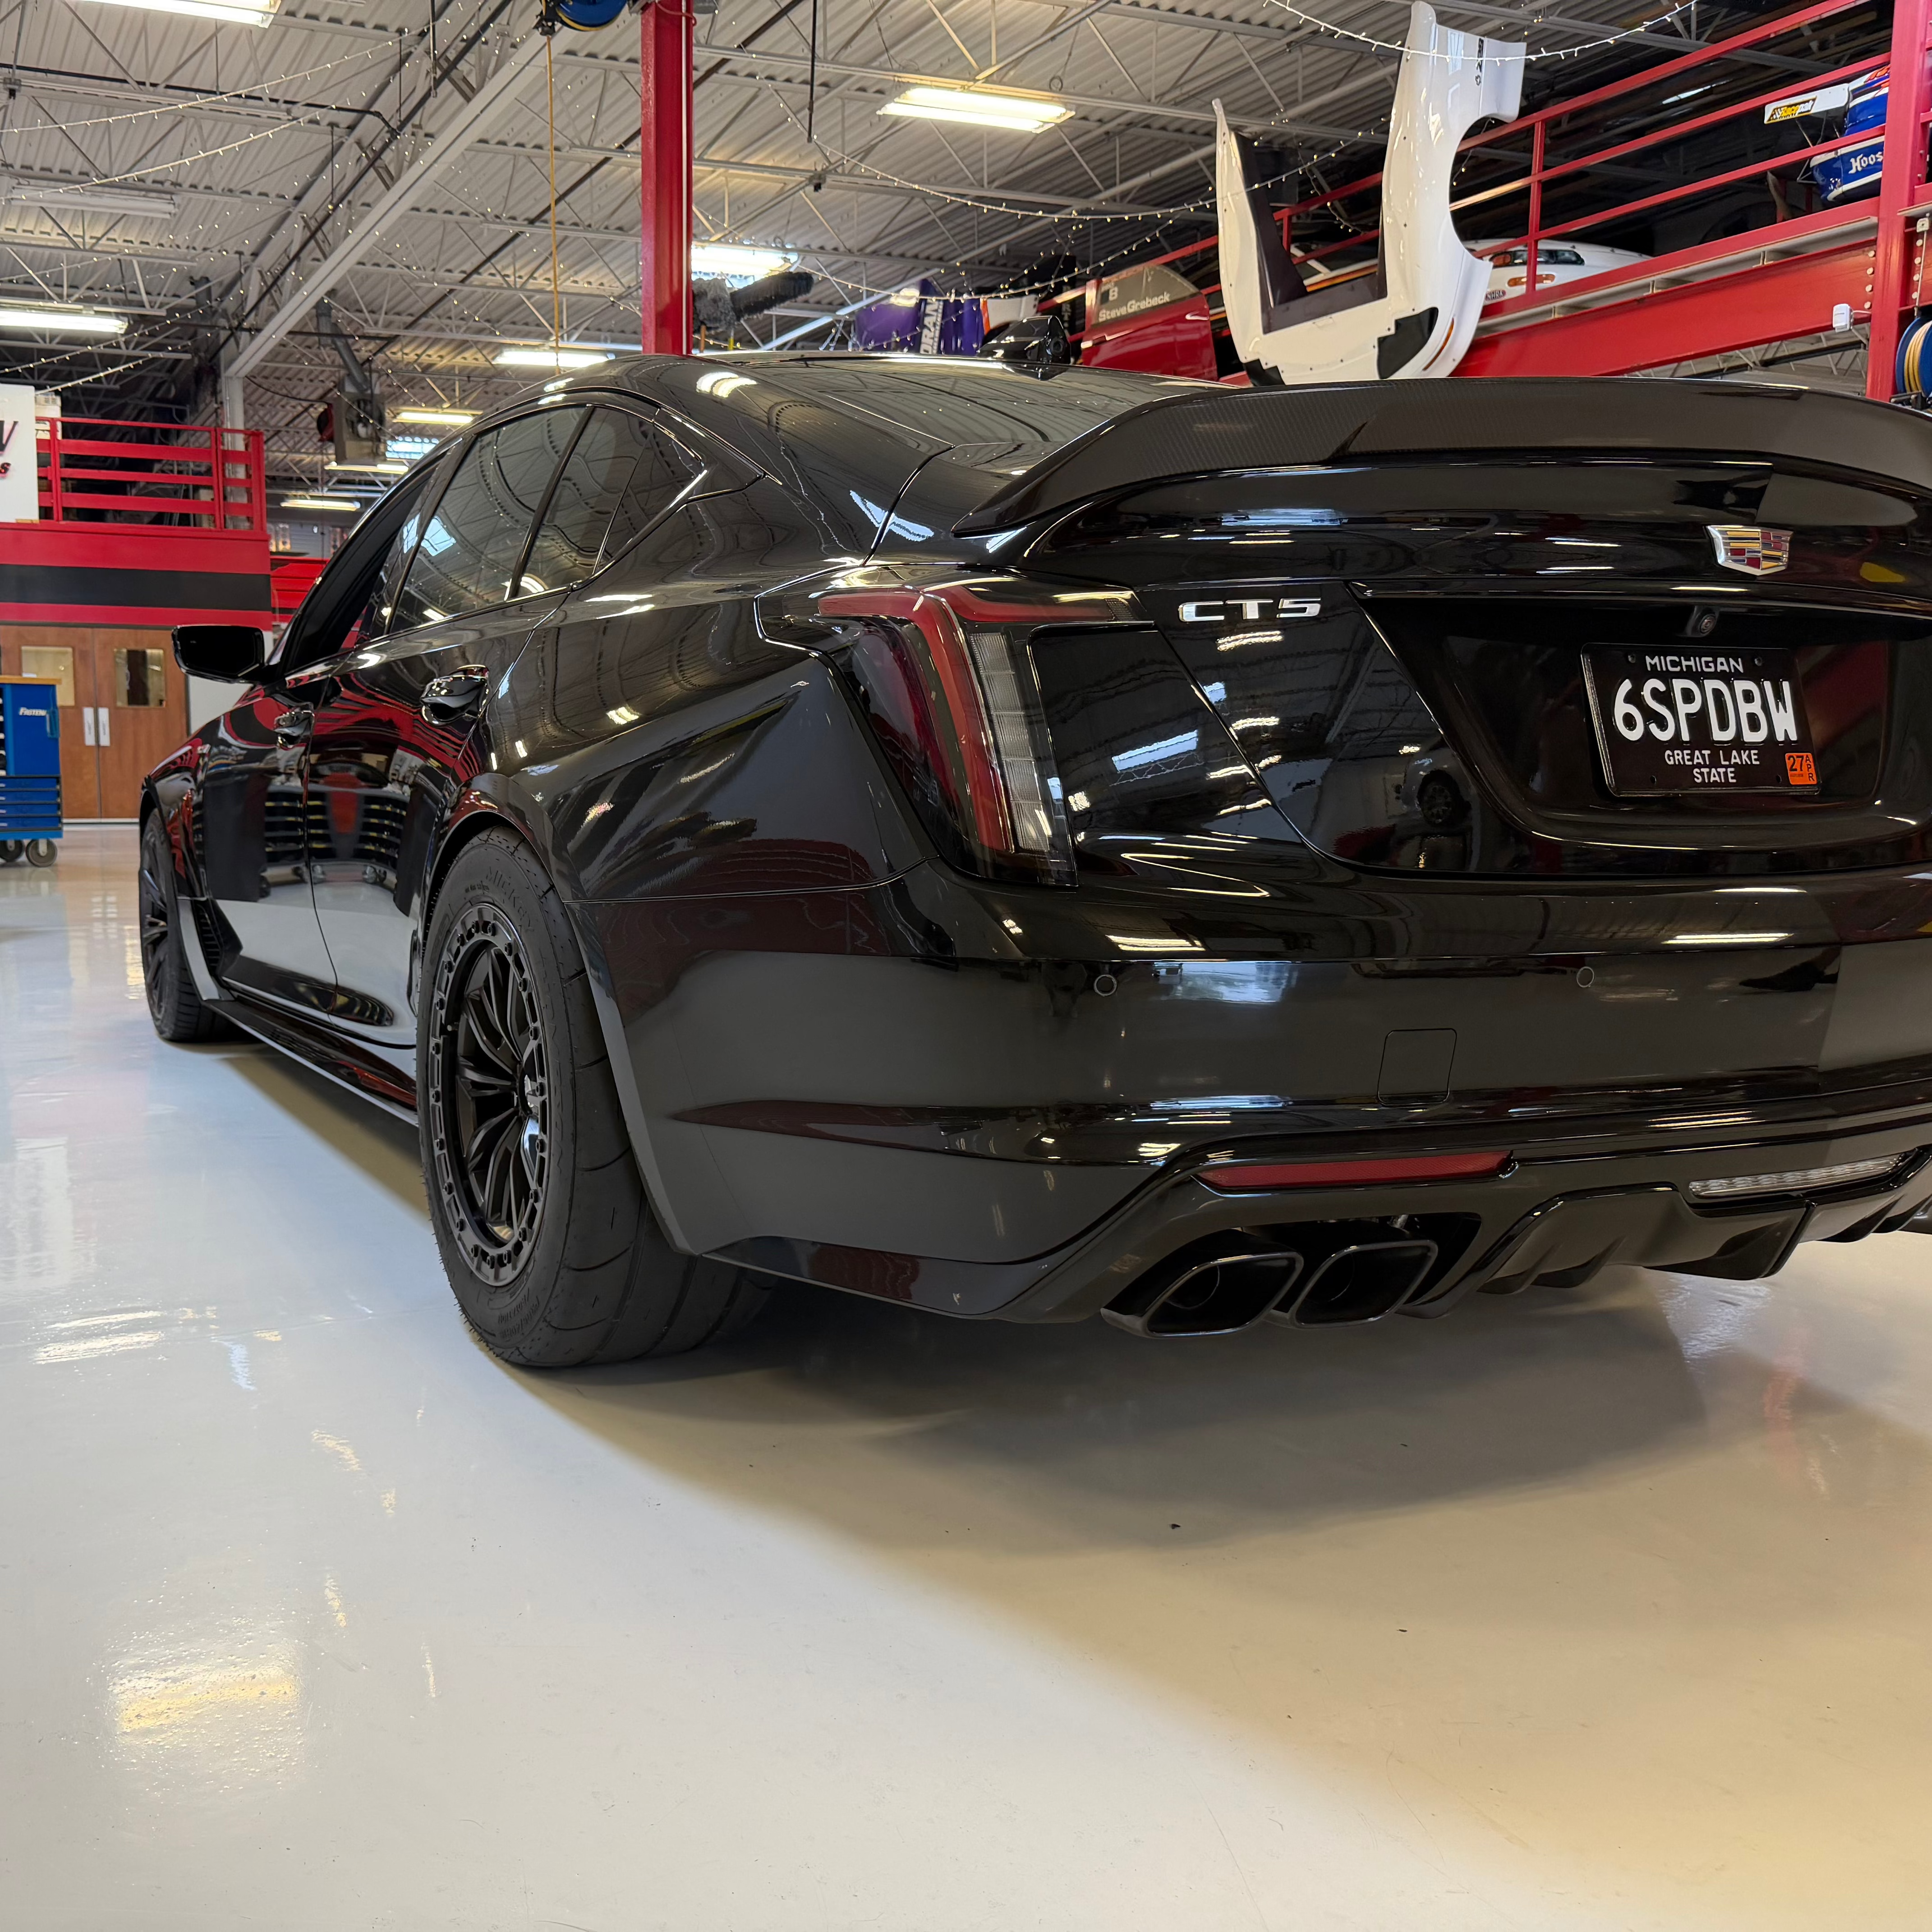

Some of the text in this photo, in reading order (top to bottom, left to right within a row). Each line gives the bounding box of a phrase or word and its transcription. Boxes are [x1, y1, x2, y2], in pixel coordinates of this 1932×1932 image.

[1486, 290, 1504, 300] NHRA
[1098, 291, 1171, 322] Steve Grebeck
[1645, 655, 1744, 673] MICHIGAN
[1614, 678, 1797, 742] 6SPDBW
[1665, 750, 1760, 765] GREAT LAKE
[1788, 755, 1804, 772] 27
[1693, 768, 1737, 783] STATE
[1805, 754, 1815, 781] APR
